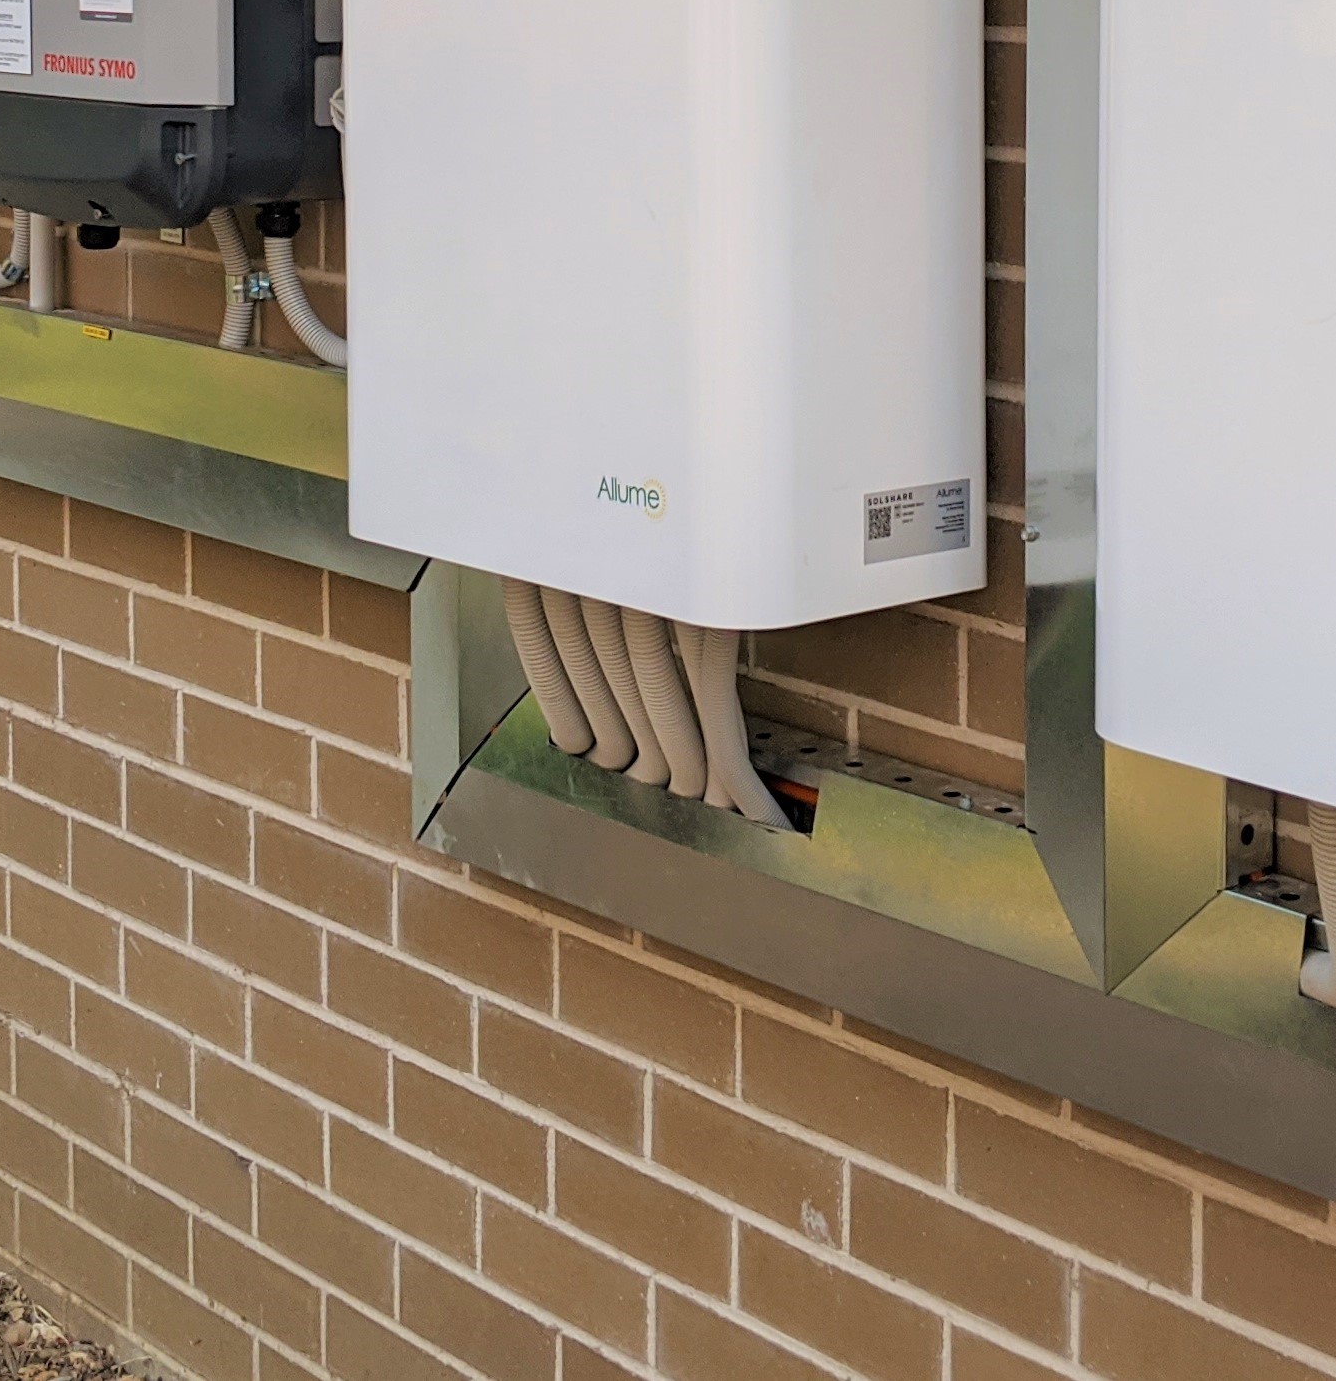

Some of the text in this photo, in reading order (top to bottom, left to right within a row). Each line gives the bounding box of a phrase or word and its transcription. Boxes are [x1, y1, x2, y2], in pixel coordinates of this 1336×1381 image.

[44, 53, 136, 80] FRONIUS SYMO
[597, 475, 660, 509] Allume
[867, 491, 913, 506] SOLSHARE
[935, 486, 963, 499] Allume
